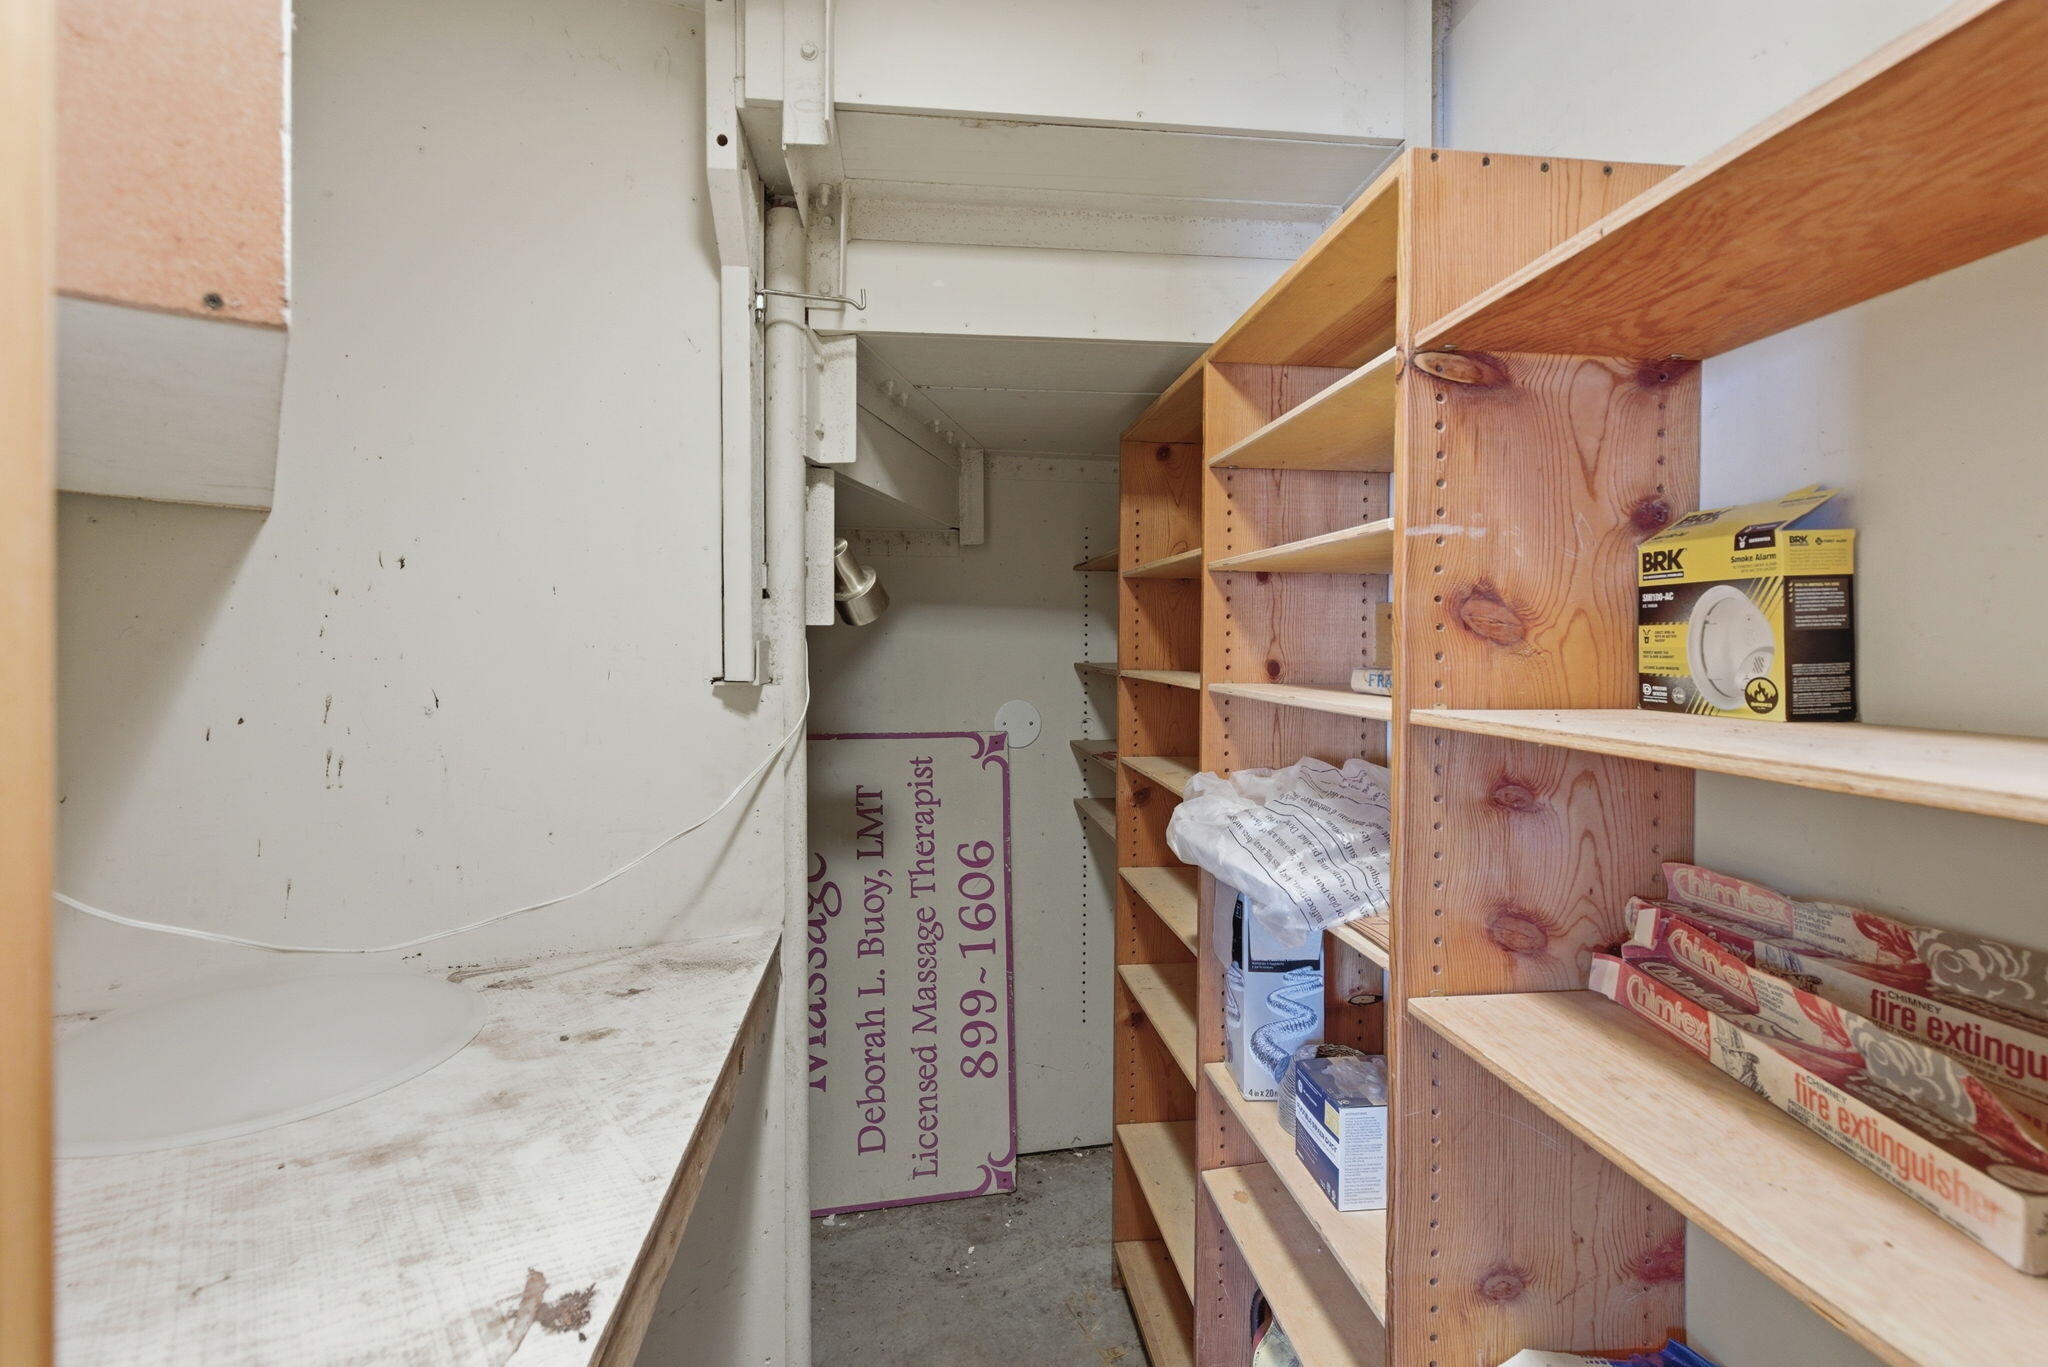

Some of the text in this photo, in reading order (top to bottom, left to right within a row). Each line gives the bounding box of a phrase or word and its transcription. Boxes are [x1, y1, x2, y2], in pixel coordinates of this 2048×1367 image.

[1642, 548, 1684, 572] BRK
[1731, 553, 1776, 563] Smoke Alarm
[1672, 868, 1793, 931] Chimfex
[856, 785, 893, 1155] Deborah L. Buoy, LMT
[908, 756, 944, 1180] Licensed Massage Therapist
[1667, 929, 1758, 1007] Chimfex
[1627, 974, 1710, 1056] Chimfex
[1887, 990, 1942, 1014] CHIMNEY
[1870, 989, 2048, 1081] fire extingu
[1265, 1089, 1274, 1098] 20
[1794, 1072, 1831, 1121] fire
[1806, 1075, 1847, 1104] CHIMNEY
